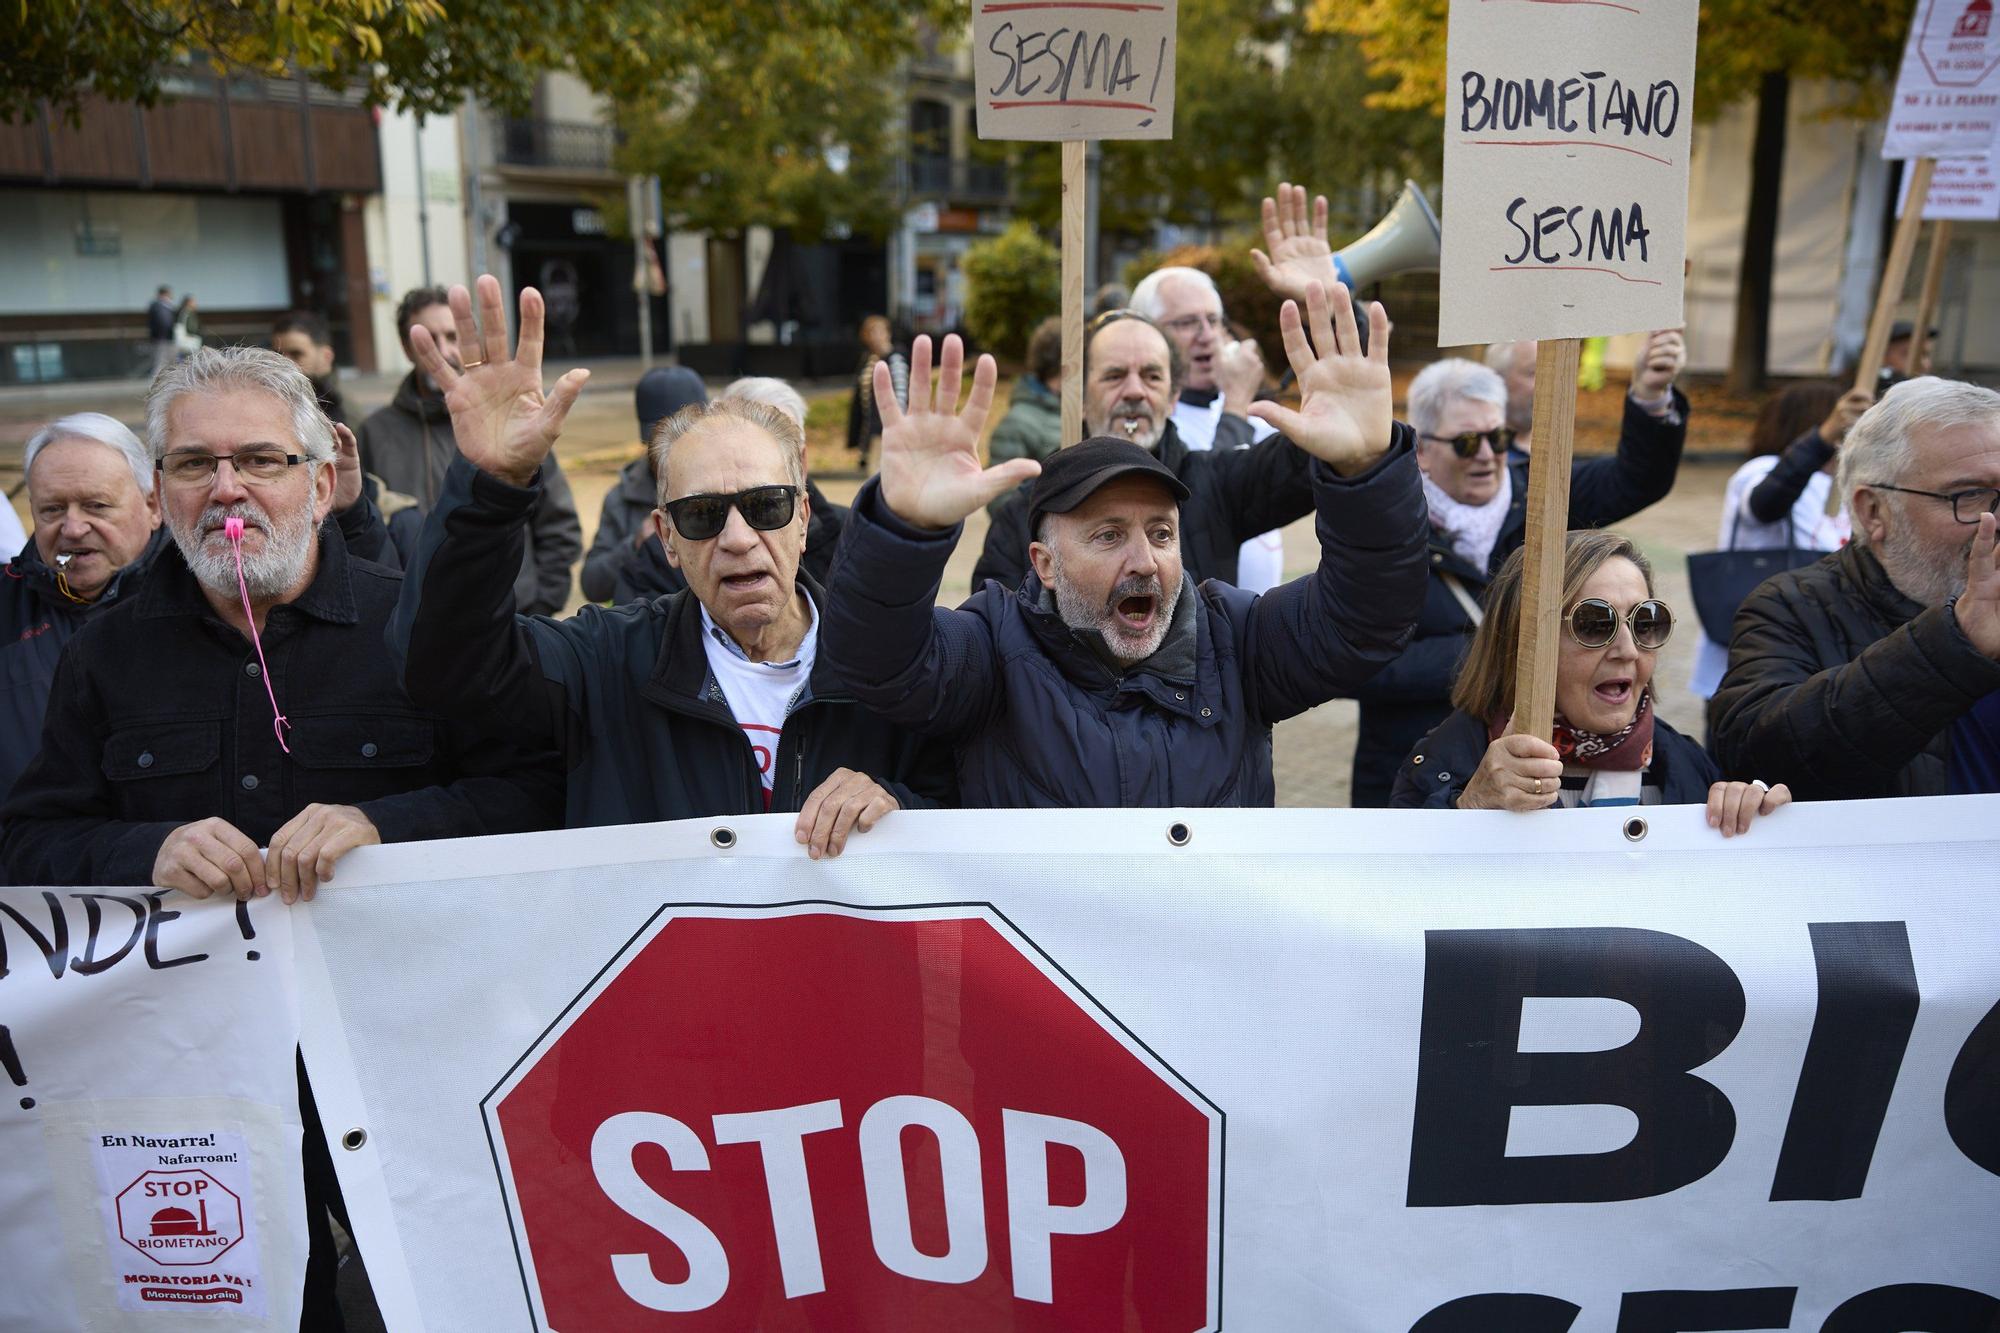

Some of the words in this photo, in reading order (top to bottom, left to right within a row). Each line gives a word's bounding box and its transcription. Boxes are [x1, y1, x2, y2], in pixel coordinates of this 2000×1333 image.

[989, 22, 1166, 127] SESMA!
[1461, 71, 1680, 138] BIOMETANO
[1504, 197, 1650, 264] SESMA
[1406, 920, 2000, 1208] BI
[101, 1135, 128, 1148] En
[131, 1134, 216, 1149] Navarra!
[158, 1153, 238, 1165] Nafarroan!
[144, 1179, 209, 1197] STOP
[590, 1094, 1128, 1312] STOP
[138, 1237, 229, 1249] BIOMETANO
[124, 1274, 221, 1285] MORATORIA
[146, 1290, 203, 1300] Moratoria
[205, 1290, 239, 1300] orain!
